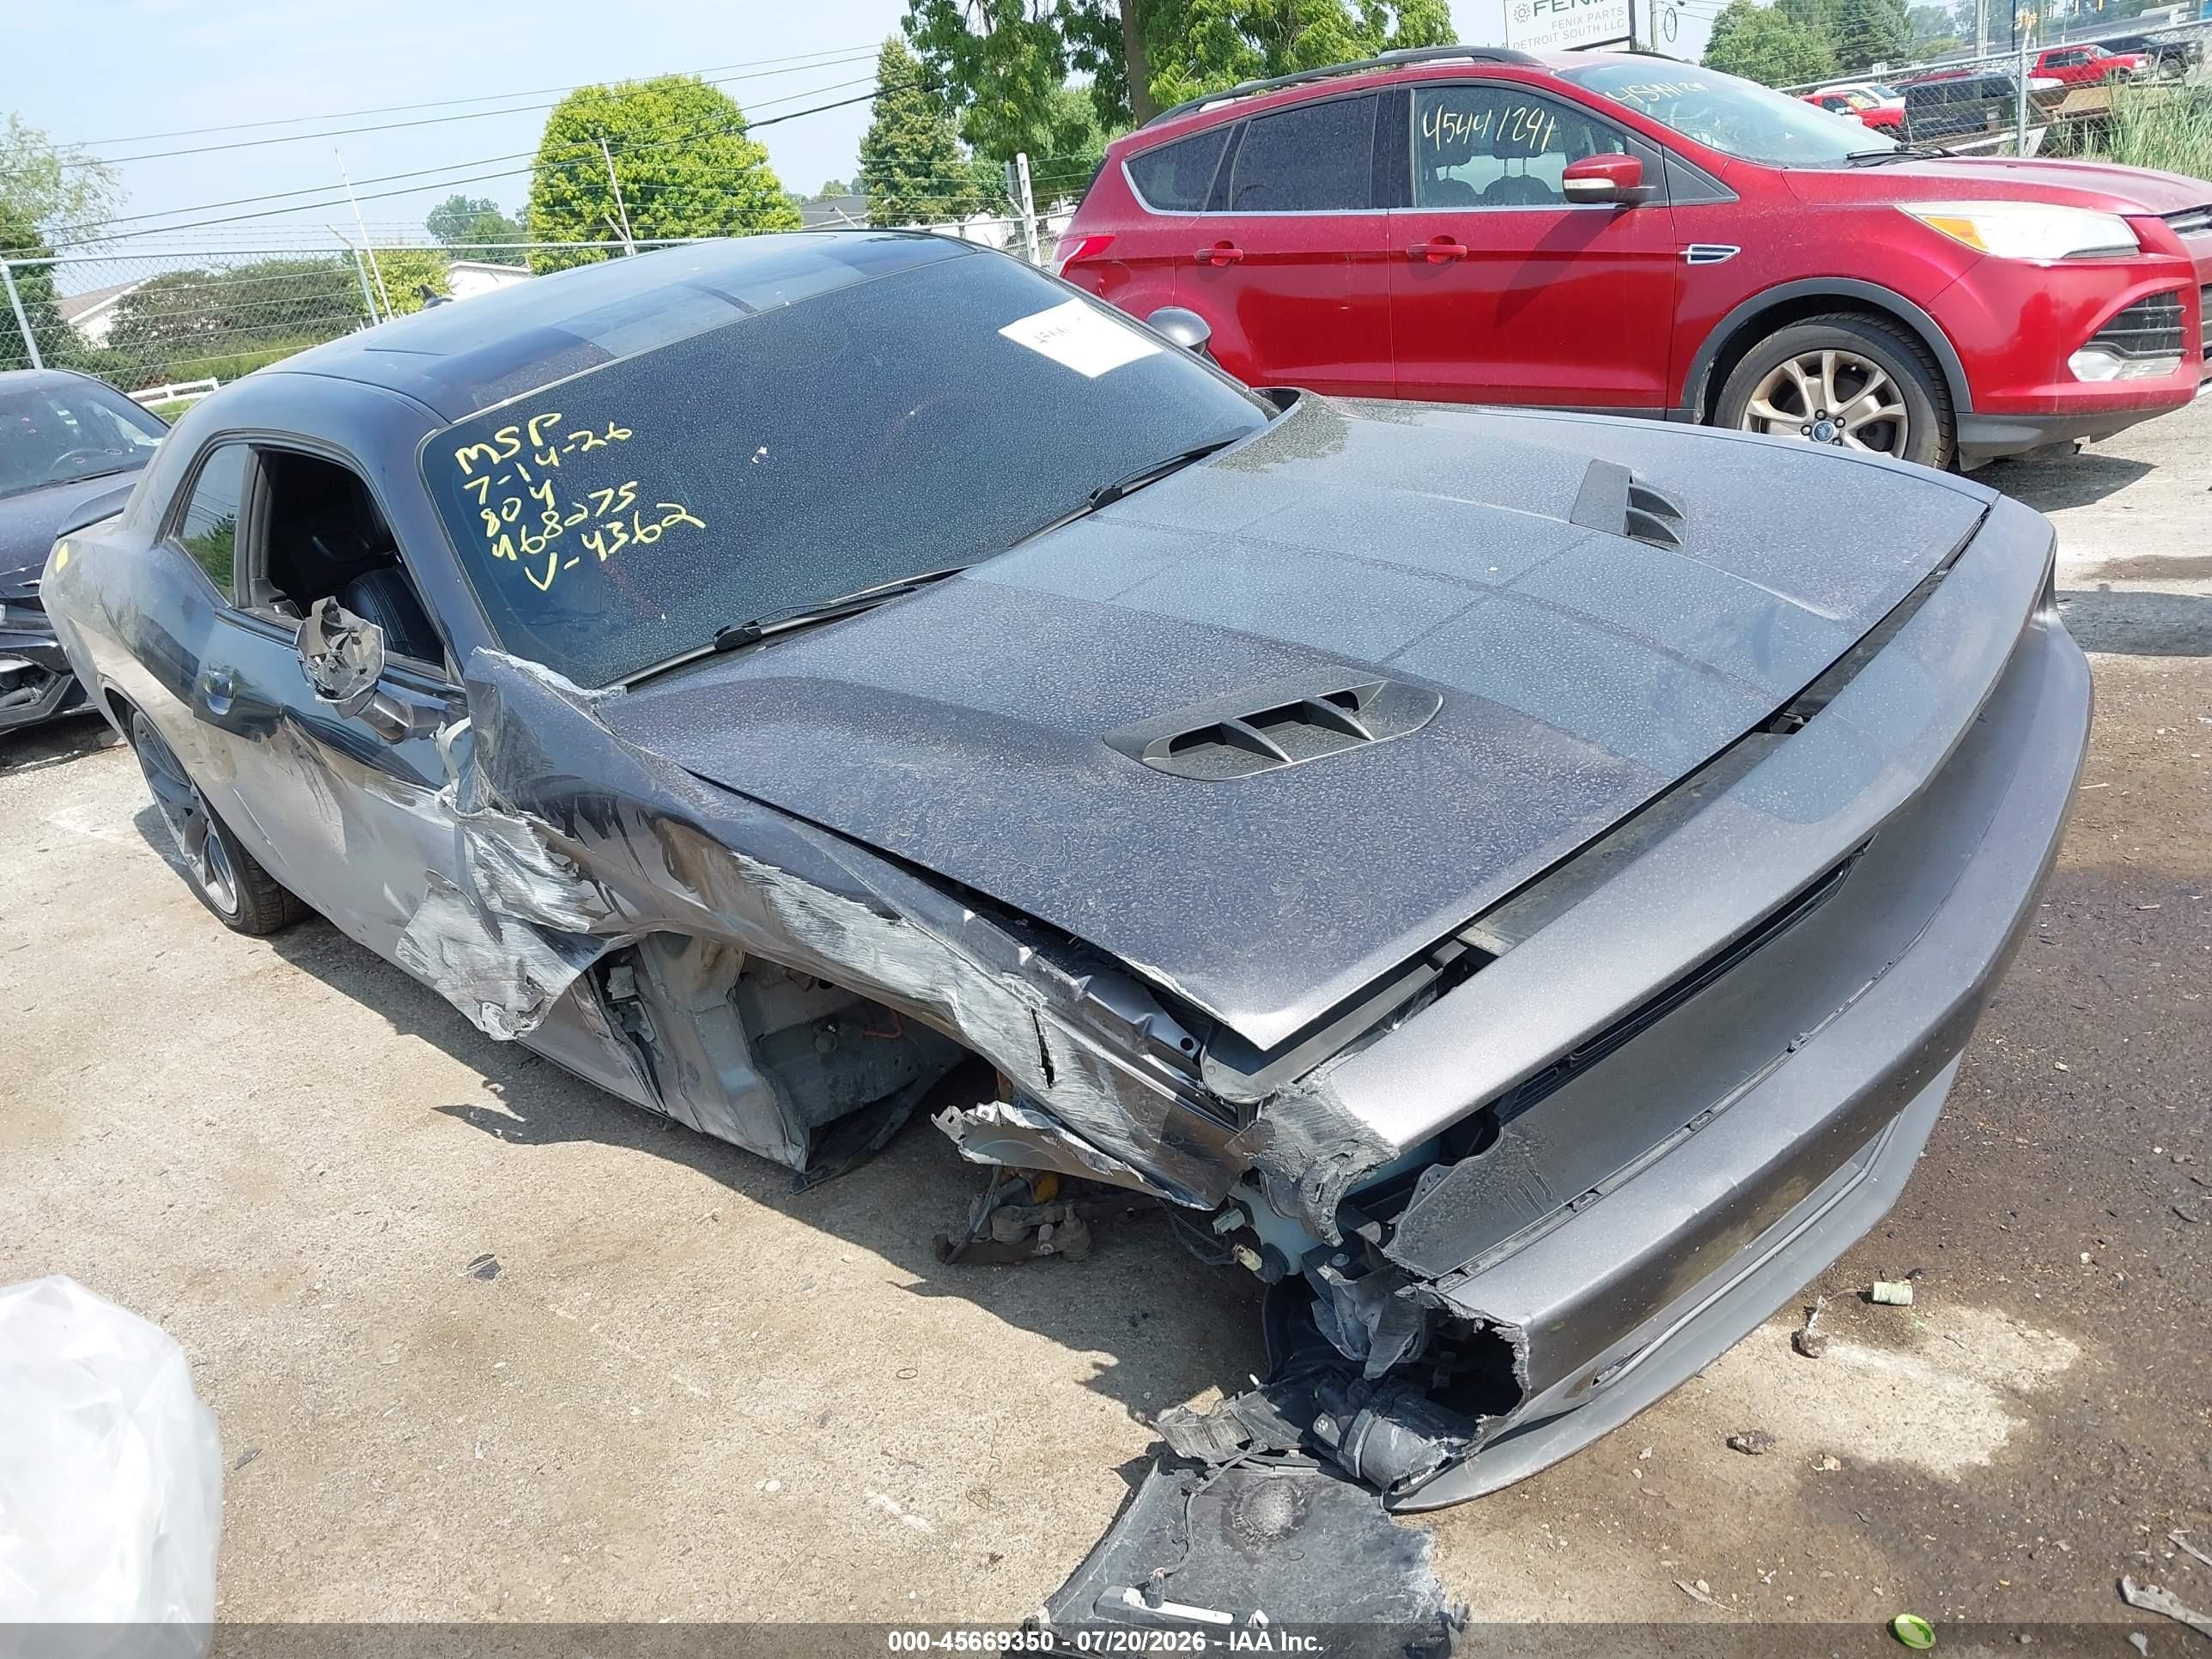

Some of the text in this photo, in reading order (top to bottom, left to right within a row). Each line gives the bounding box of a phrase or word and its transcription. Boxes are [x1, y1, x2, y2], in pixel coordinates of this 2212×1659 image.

[1513, 18, 1625, 50] DETROIT SOUTH LLC
[1552, 6, 1625, 30] FENIX PARTS
[454, 412, 562, 475] MSP
[463, 422, 633, 505] 7-14-26
[481, 479, 555, 538] 804
[525, 503, 707, 592] V-4362
